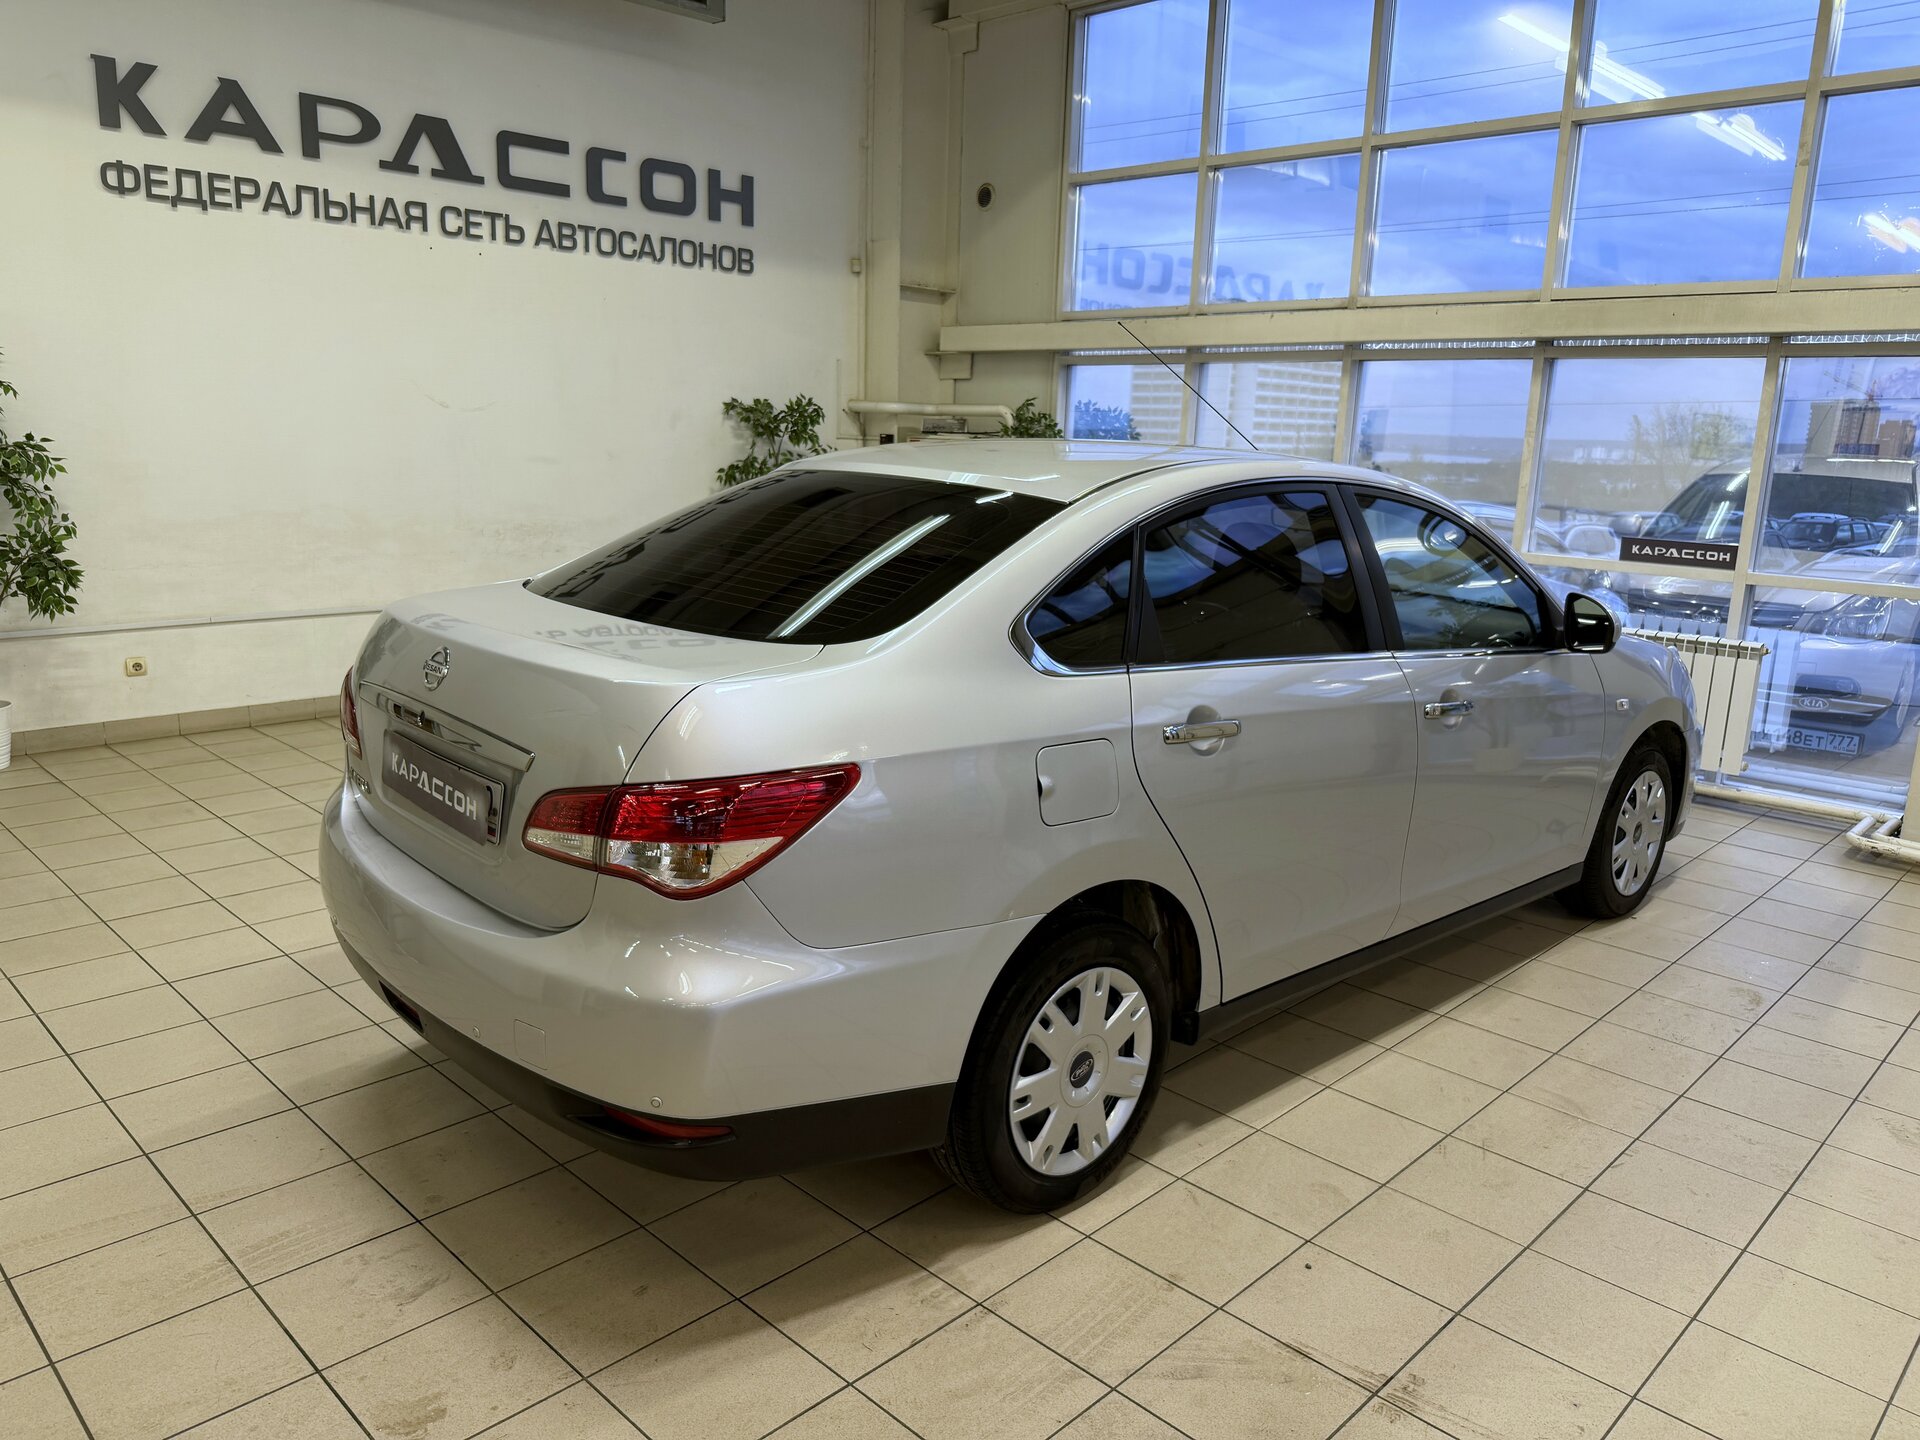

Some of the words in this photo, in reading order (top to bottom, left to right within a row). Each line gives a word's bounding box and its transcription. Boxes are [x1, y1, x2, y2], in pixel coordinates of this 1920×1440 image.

[99, 159, 428, 233] ФЕДЕРАЛЬНАЯ
[440, 206, 525, 244] СЕТЬ
[534, 219, 754, 275] АВТОСАЛОНОВ
[1803, 697, 1823, 708] KIA
